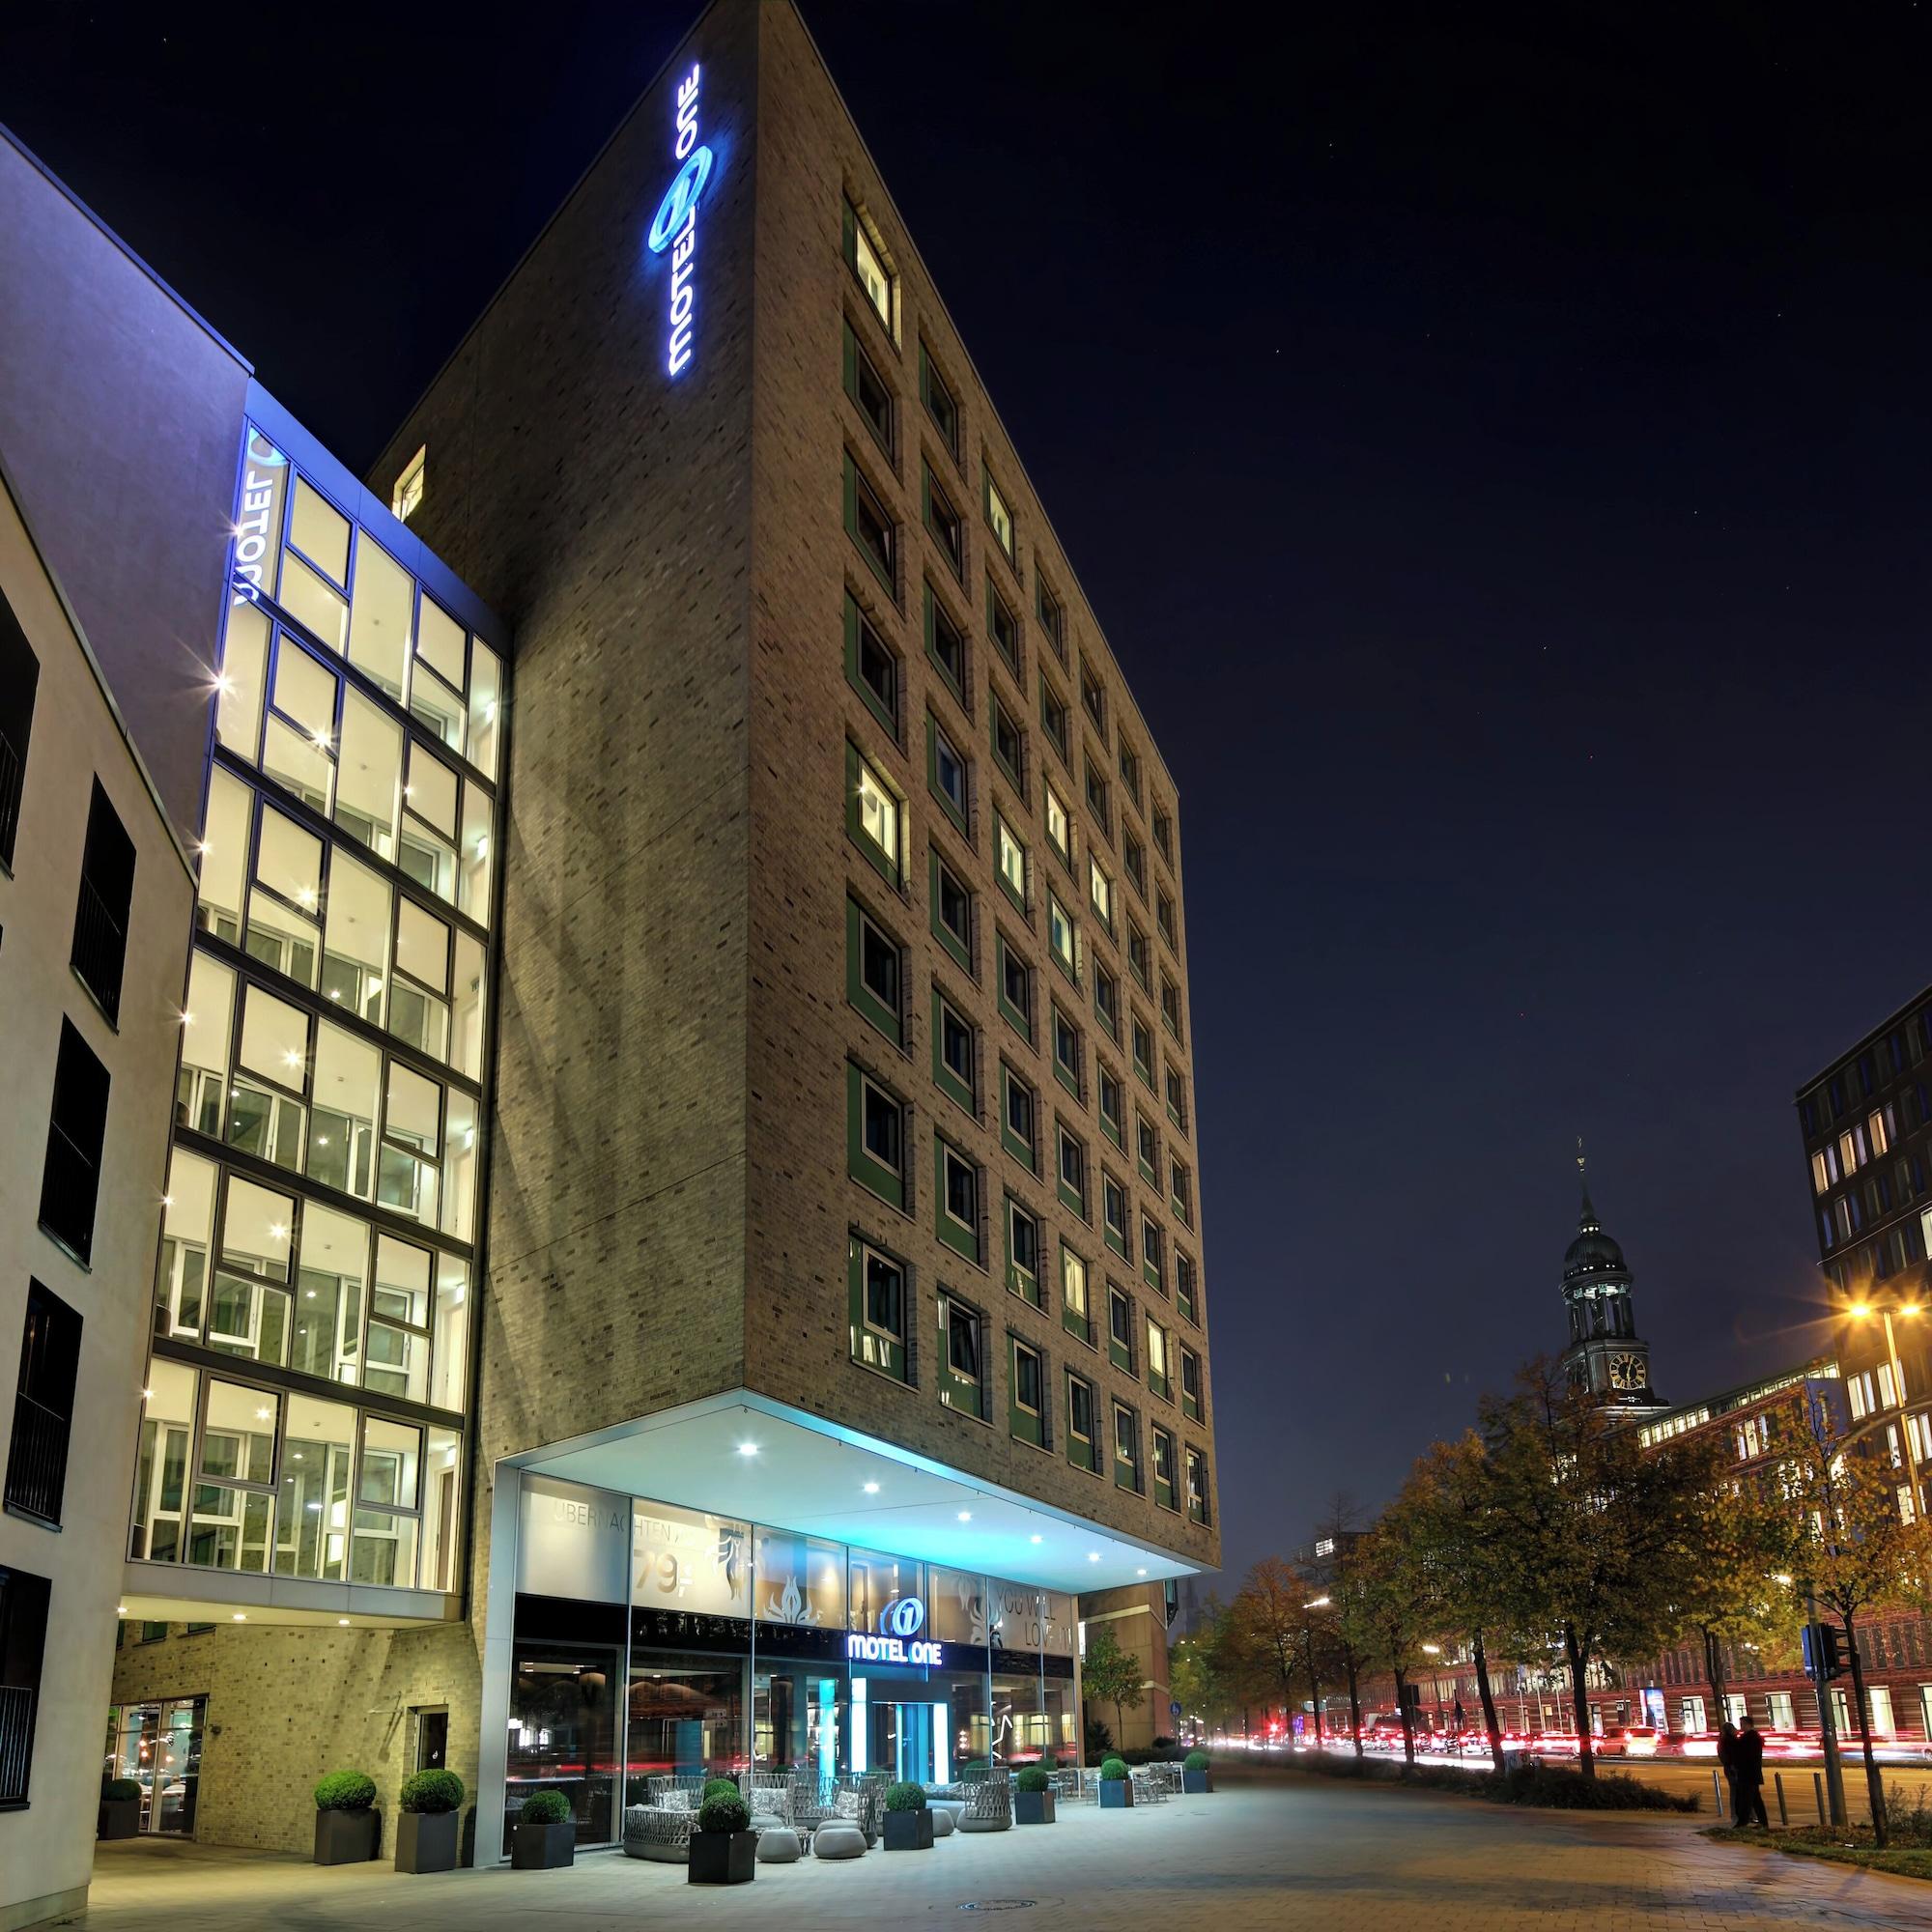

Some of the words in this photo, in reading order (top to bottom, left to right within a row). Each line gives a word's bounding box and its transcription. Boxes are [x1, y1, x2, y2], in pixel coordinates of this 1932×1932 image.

[675, 64, 699, 159] ONE
[668, 205, 696, 376] MOTEL
[997, 1585, 1023, 1615] YOU
[848, 1634, 908, 1662] MOTEL
[911, 1641, 943, 1665] ONE
